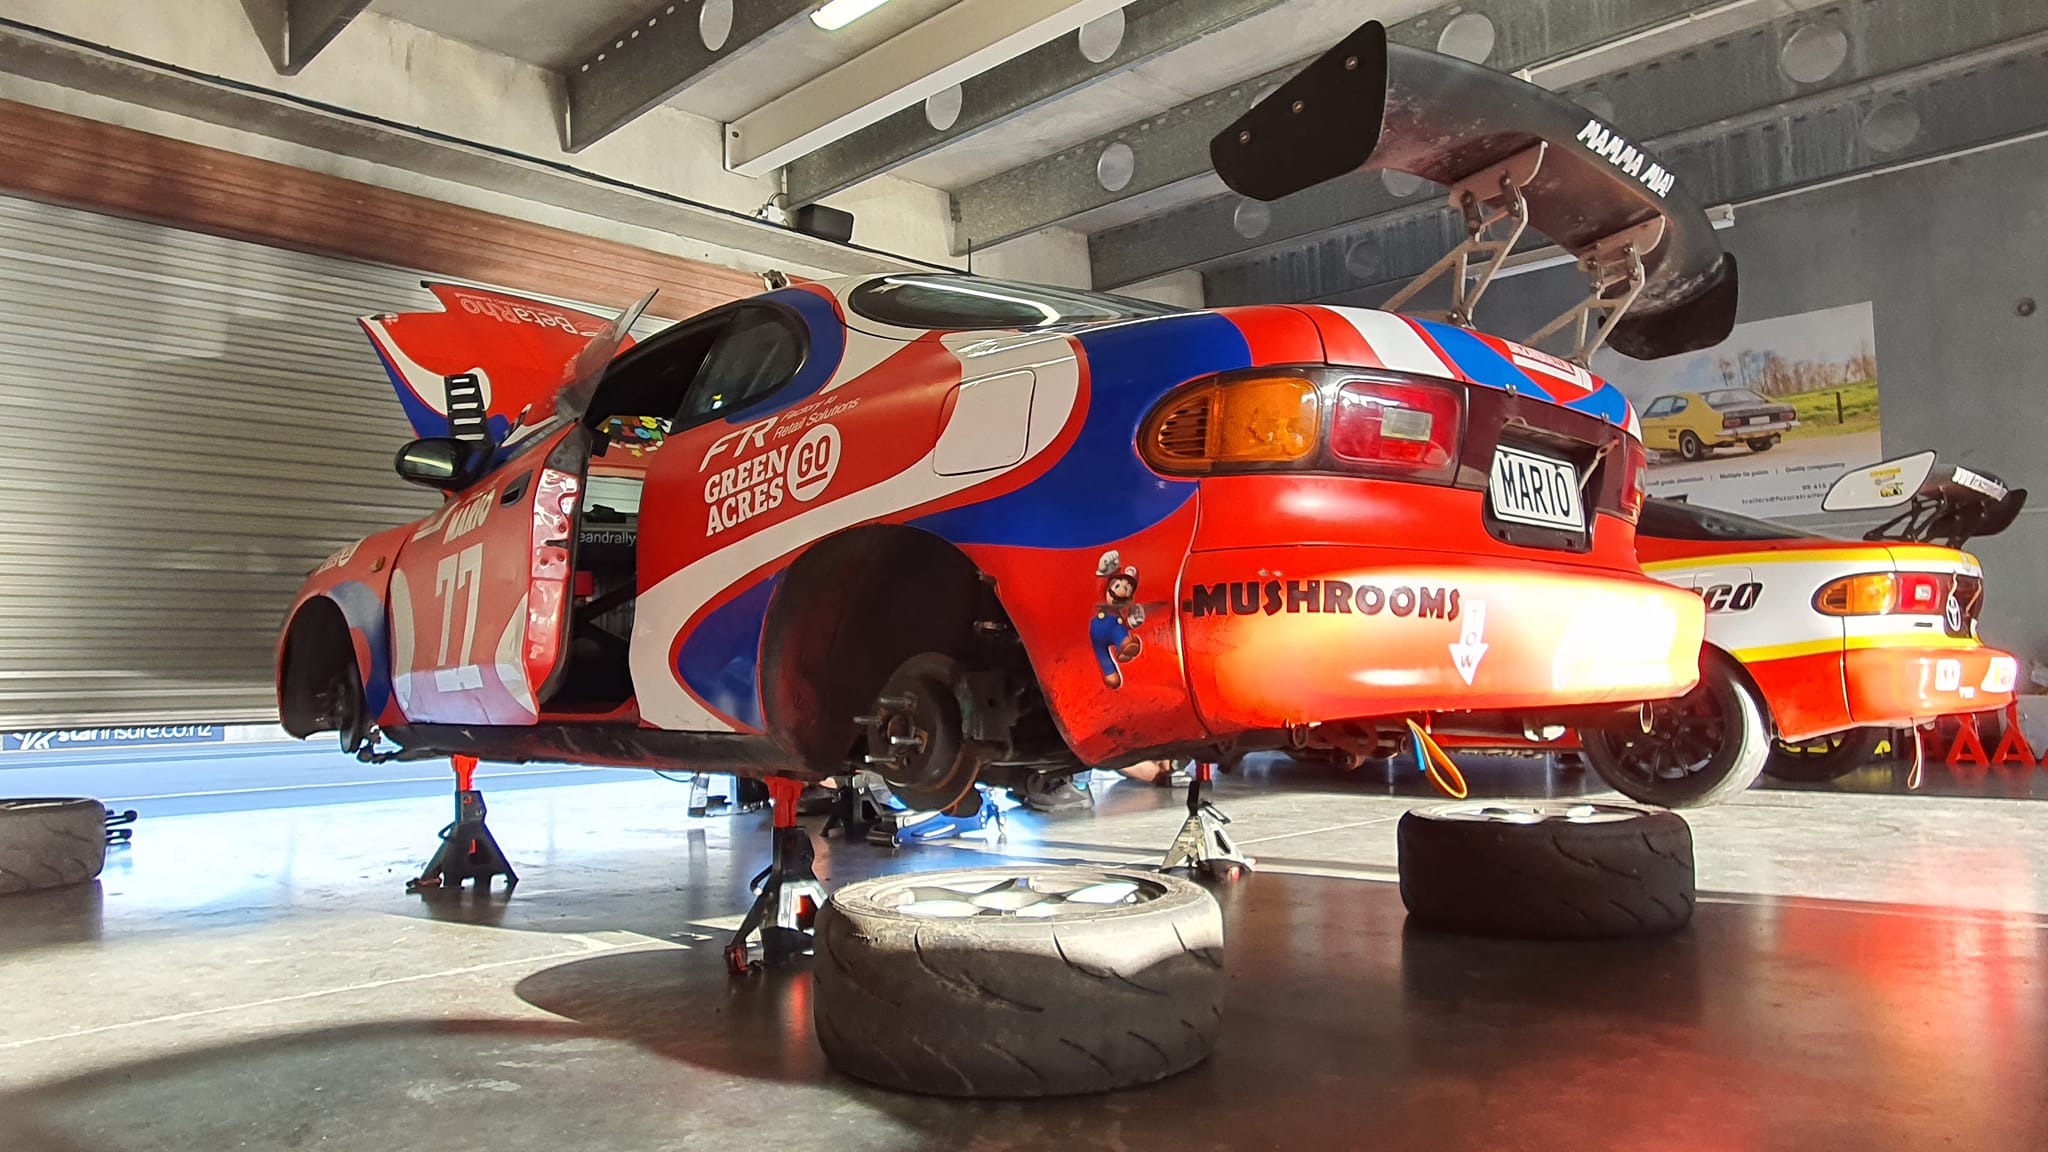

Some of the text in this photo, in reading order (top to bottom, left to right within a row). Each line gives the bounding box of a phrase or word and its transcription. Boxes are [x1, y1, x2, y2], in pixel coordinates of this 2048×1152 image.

[1576, 119, 1645, 177] MAMMA
[460, 297, 579, 336] BetaRho
[773, 396, 861, 440] Retail Solutions
[704, 444, 789, 504] GREEN
[1499, 457, 1571, 518] MARIO
[705, 475, 785, 537] ACRES
[435, 542, 484, 667] 77
[1191, 579, 1460, 623] MUSHROOMS
[1460, 608, 1478, 669] TOW
